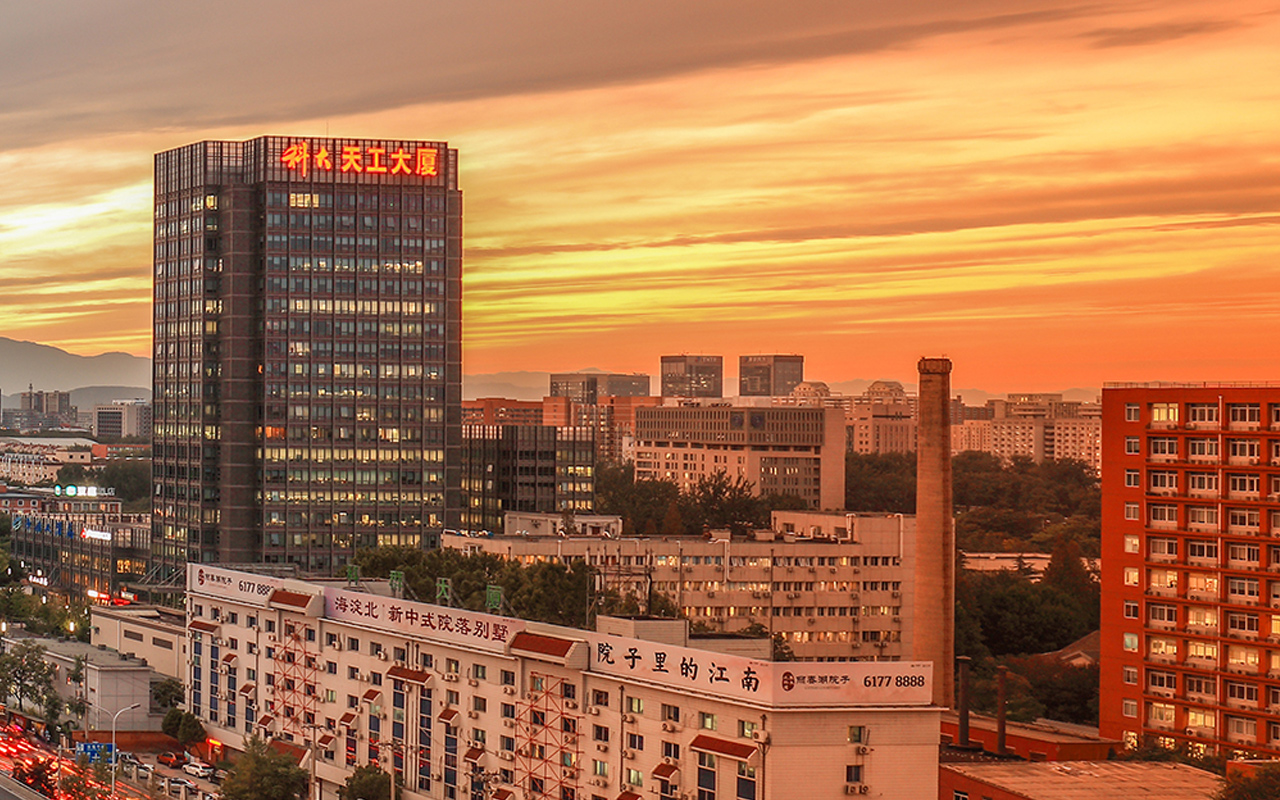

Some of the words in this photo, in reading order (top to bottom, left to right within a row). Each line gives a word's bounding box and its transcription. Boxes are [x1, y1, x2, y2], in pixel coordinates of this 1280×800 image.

[281, 140, 438, 177] 科大天工大厦
[239, 580, 255, 593] 6177
[257, 584, 274, 596] 888
[334, 597, 379, 619] 海淀北
[388, 605, 509, 643] 新中式院落别墅
[597, 642, 759, 692] 院子里的江南
[863, 675, 891, 687] 6177
[895, 675, 925, 687] 8888
